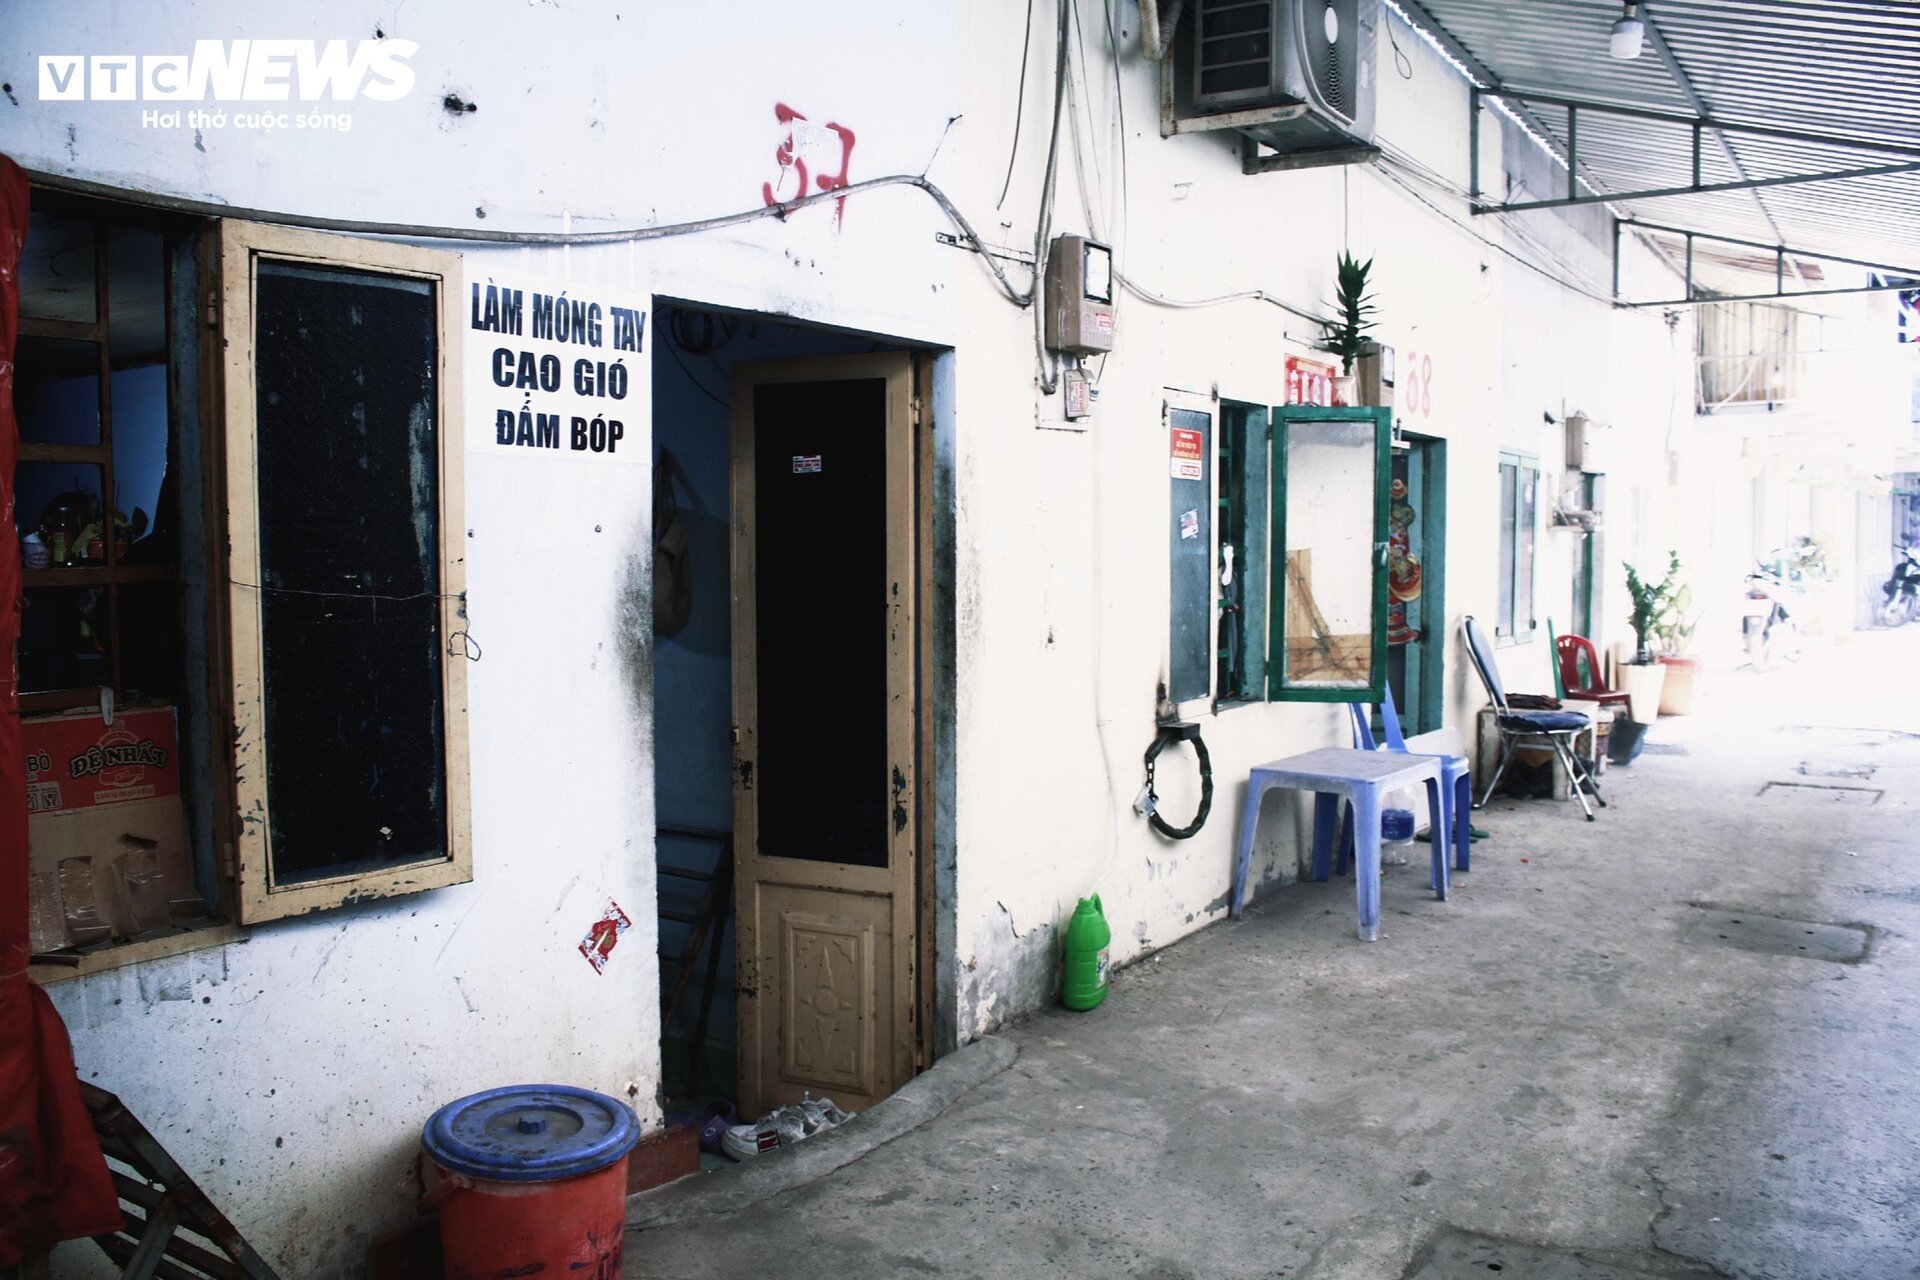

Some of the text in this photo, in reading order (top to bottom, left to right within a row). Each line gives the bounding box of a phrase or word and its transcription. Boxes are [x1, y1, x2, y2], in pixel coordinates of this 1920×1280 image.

[471, 277, 647, 353] LÀM MÓNG TAY
[492, 347, 628, 401] CẠO GIÓ
[495, 400, 624, 453] ĐẤM BÓP
[26, 749, 52, 774] BÒ
[71, 738, 168, 778] ĐỆ NHẤT
